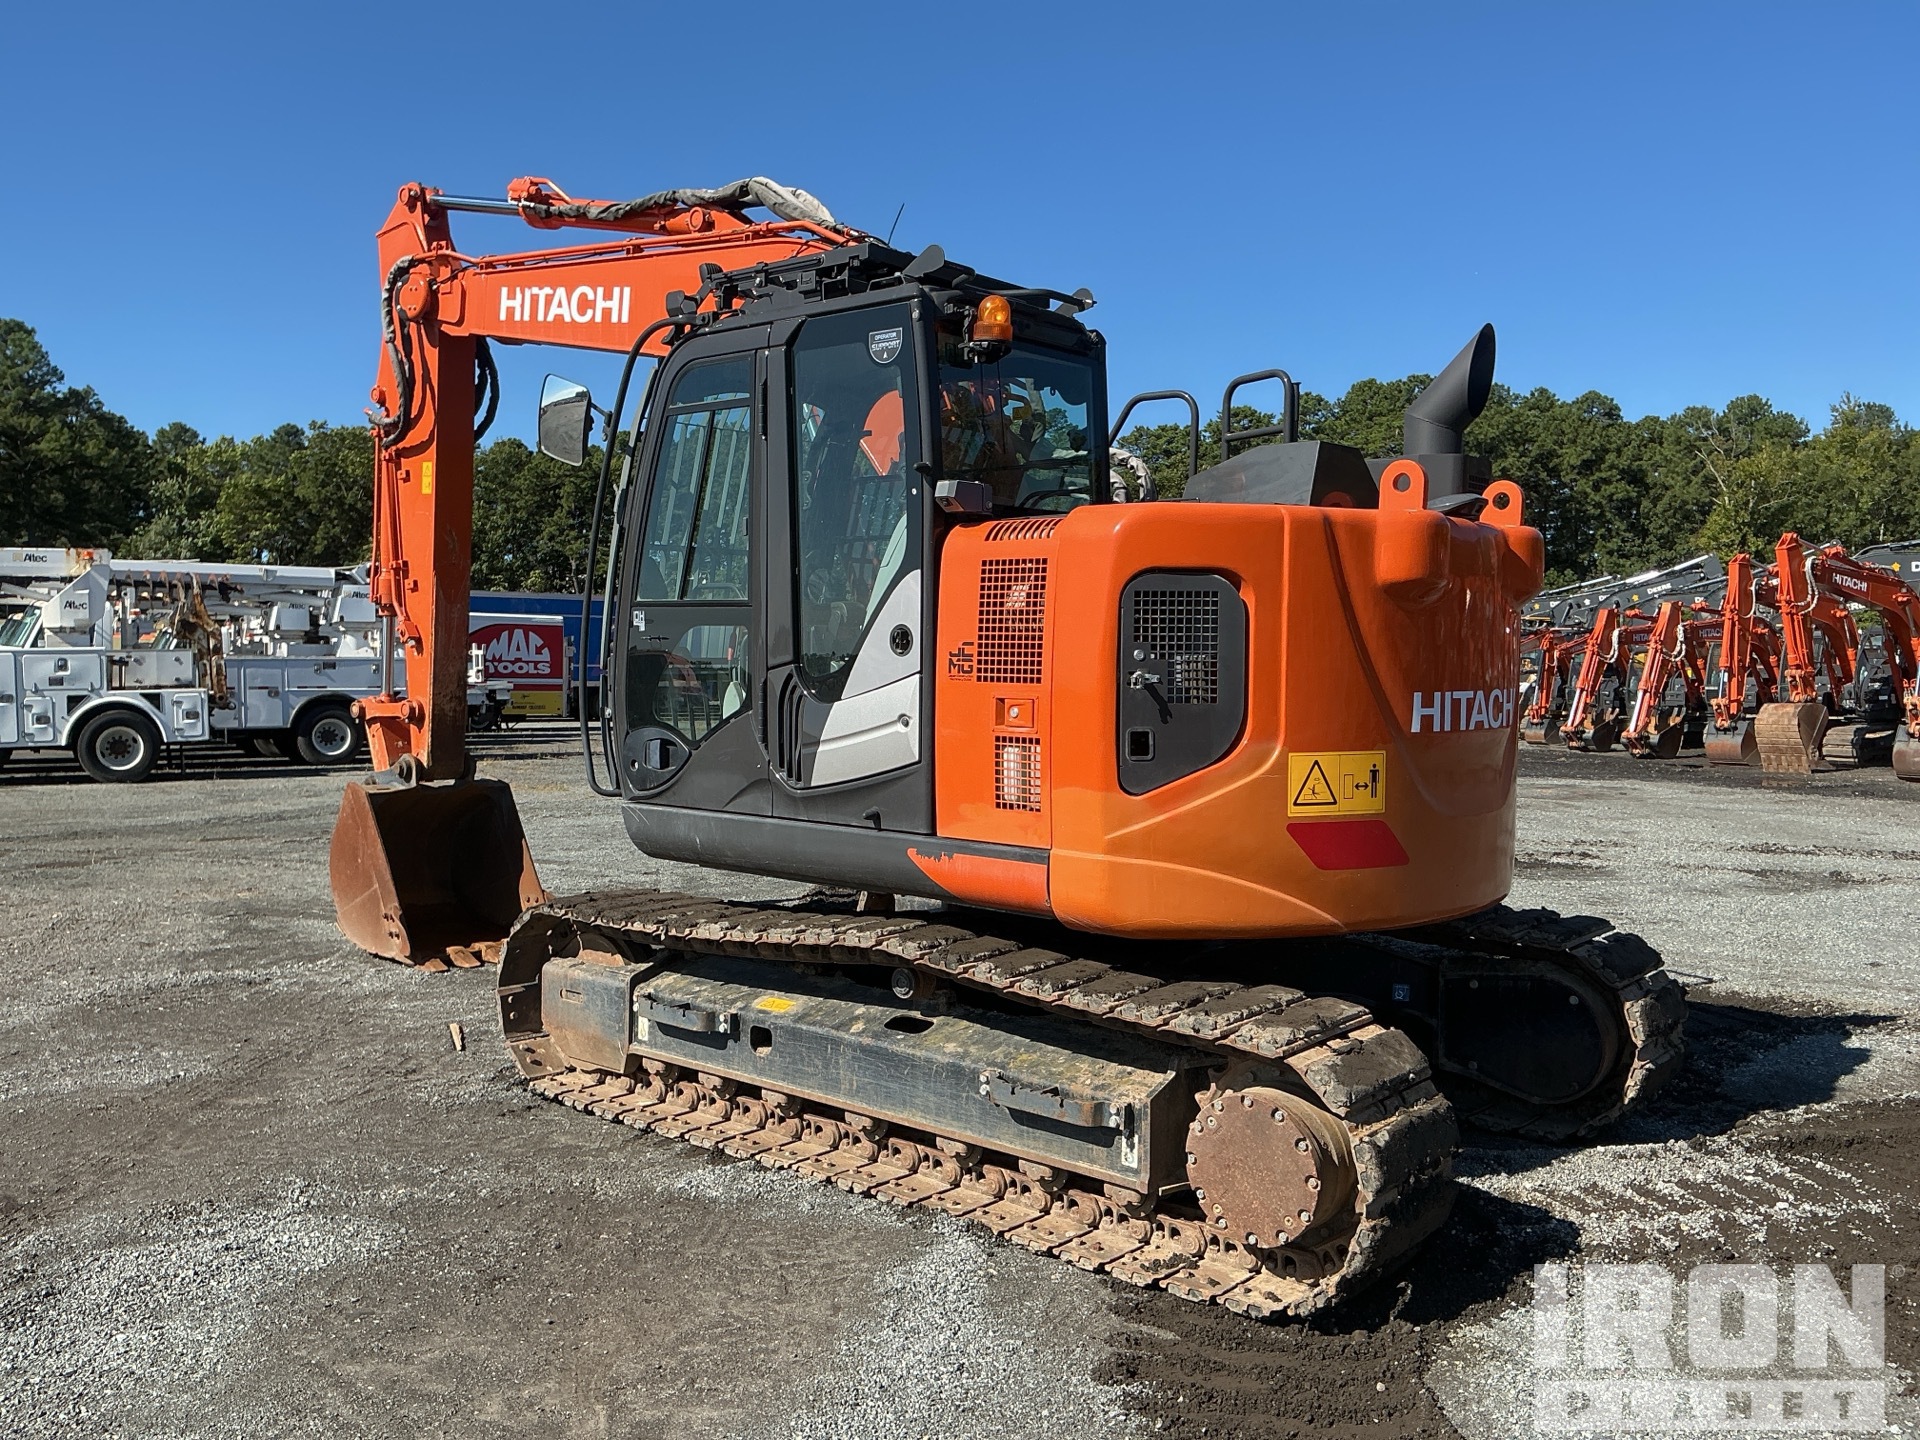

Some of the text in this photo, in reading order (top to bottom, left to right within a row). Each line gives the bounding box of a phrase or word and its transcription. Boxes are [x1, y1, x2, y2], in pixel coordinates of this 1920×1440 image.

[499, 285, 631, 323] HITACHI
[874, 332, 897, 340] OPERATOR
[24, 553, 47, 563] Altec
[1646, 582, 1671, 594] DEERE
[1832, 573, 1868, 592] HITACHI
[64, 600, 88, 610] Altec
[1632, 633, 1649, 642] HITA
[1699, 627, 1723, 639] HITAC
[485, 628, 551, 662] MAC
[485, 661, 551, 675] TOOLS
